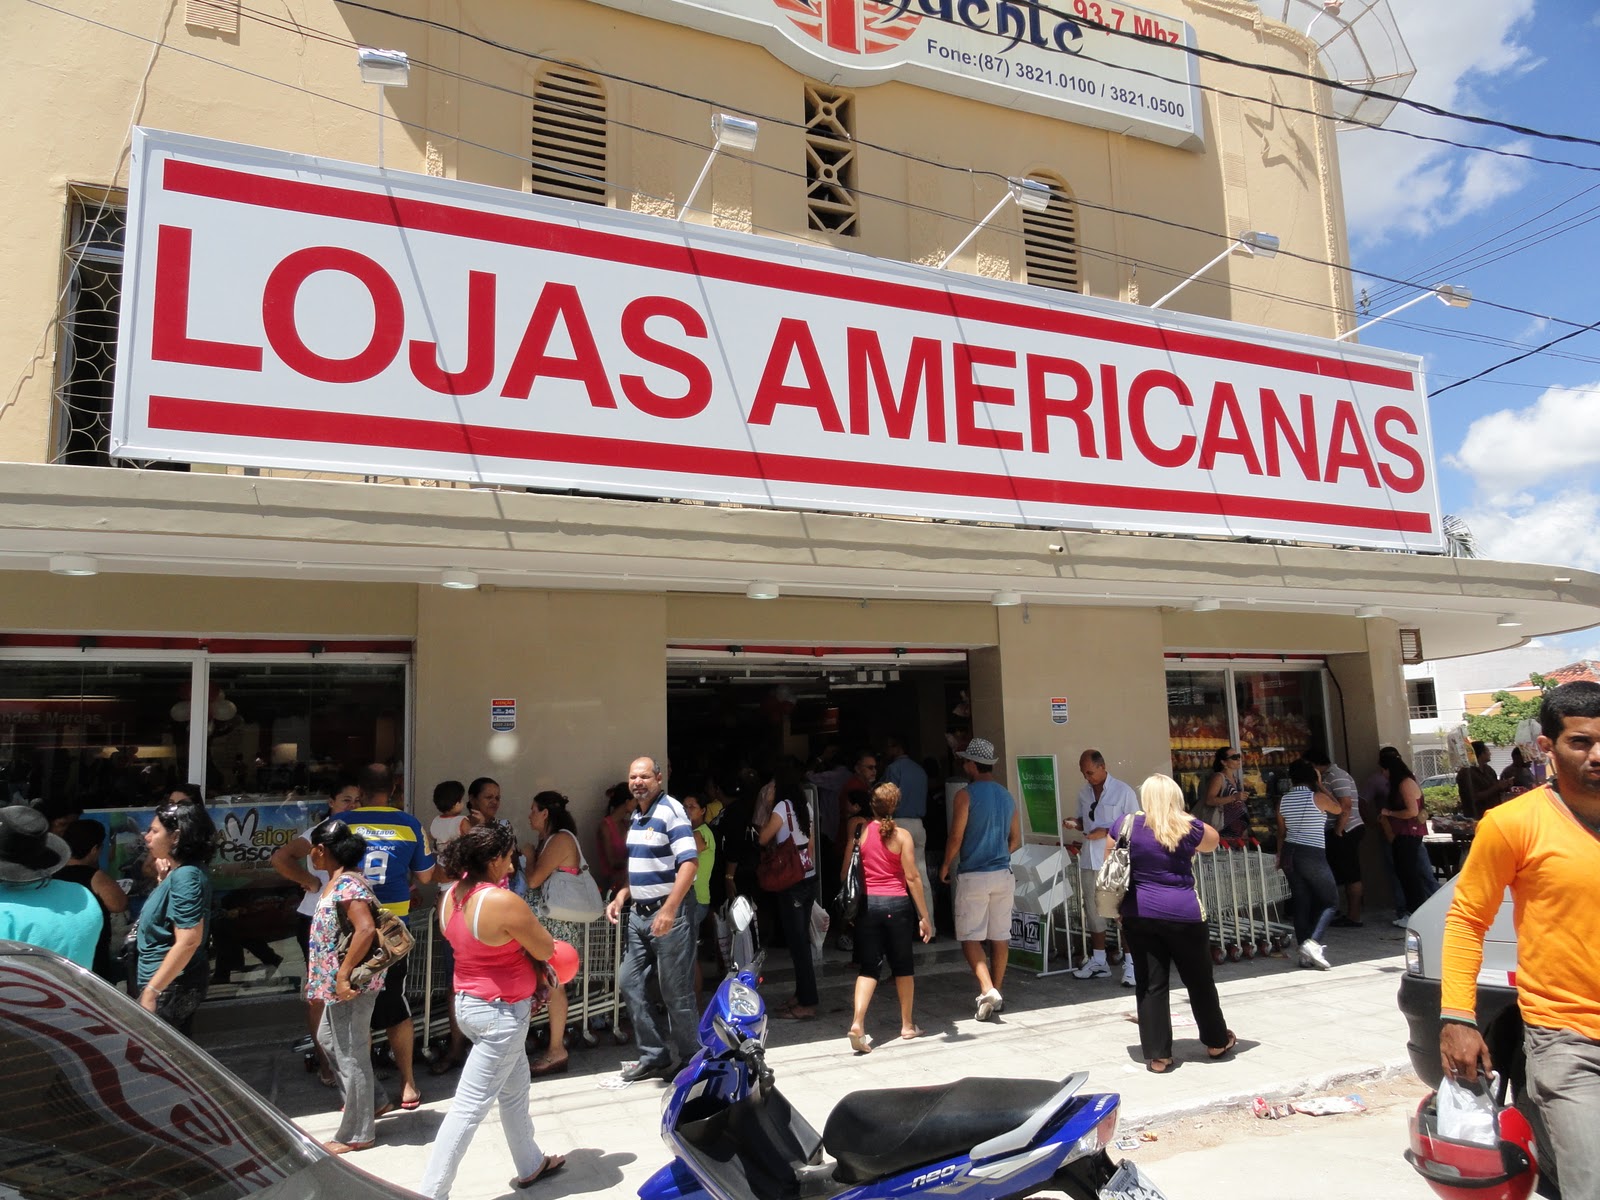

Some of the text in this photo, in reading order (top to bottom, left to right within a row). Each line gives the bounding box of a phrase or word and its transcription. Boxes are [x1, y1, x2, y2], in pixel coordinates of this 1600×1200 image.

[927, 38, 1010, 78] Fone:(87)
[1015, 62, 1096, 95] 3821.0100
[1110, 86, 1185, 118] 3821.0500
[152, 225, 1424, 493] LOJAS AMERICANAS
[363, 850, 390, 885] 9
[911, 1164, 956, 1188] neo
